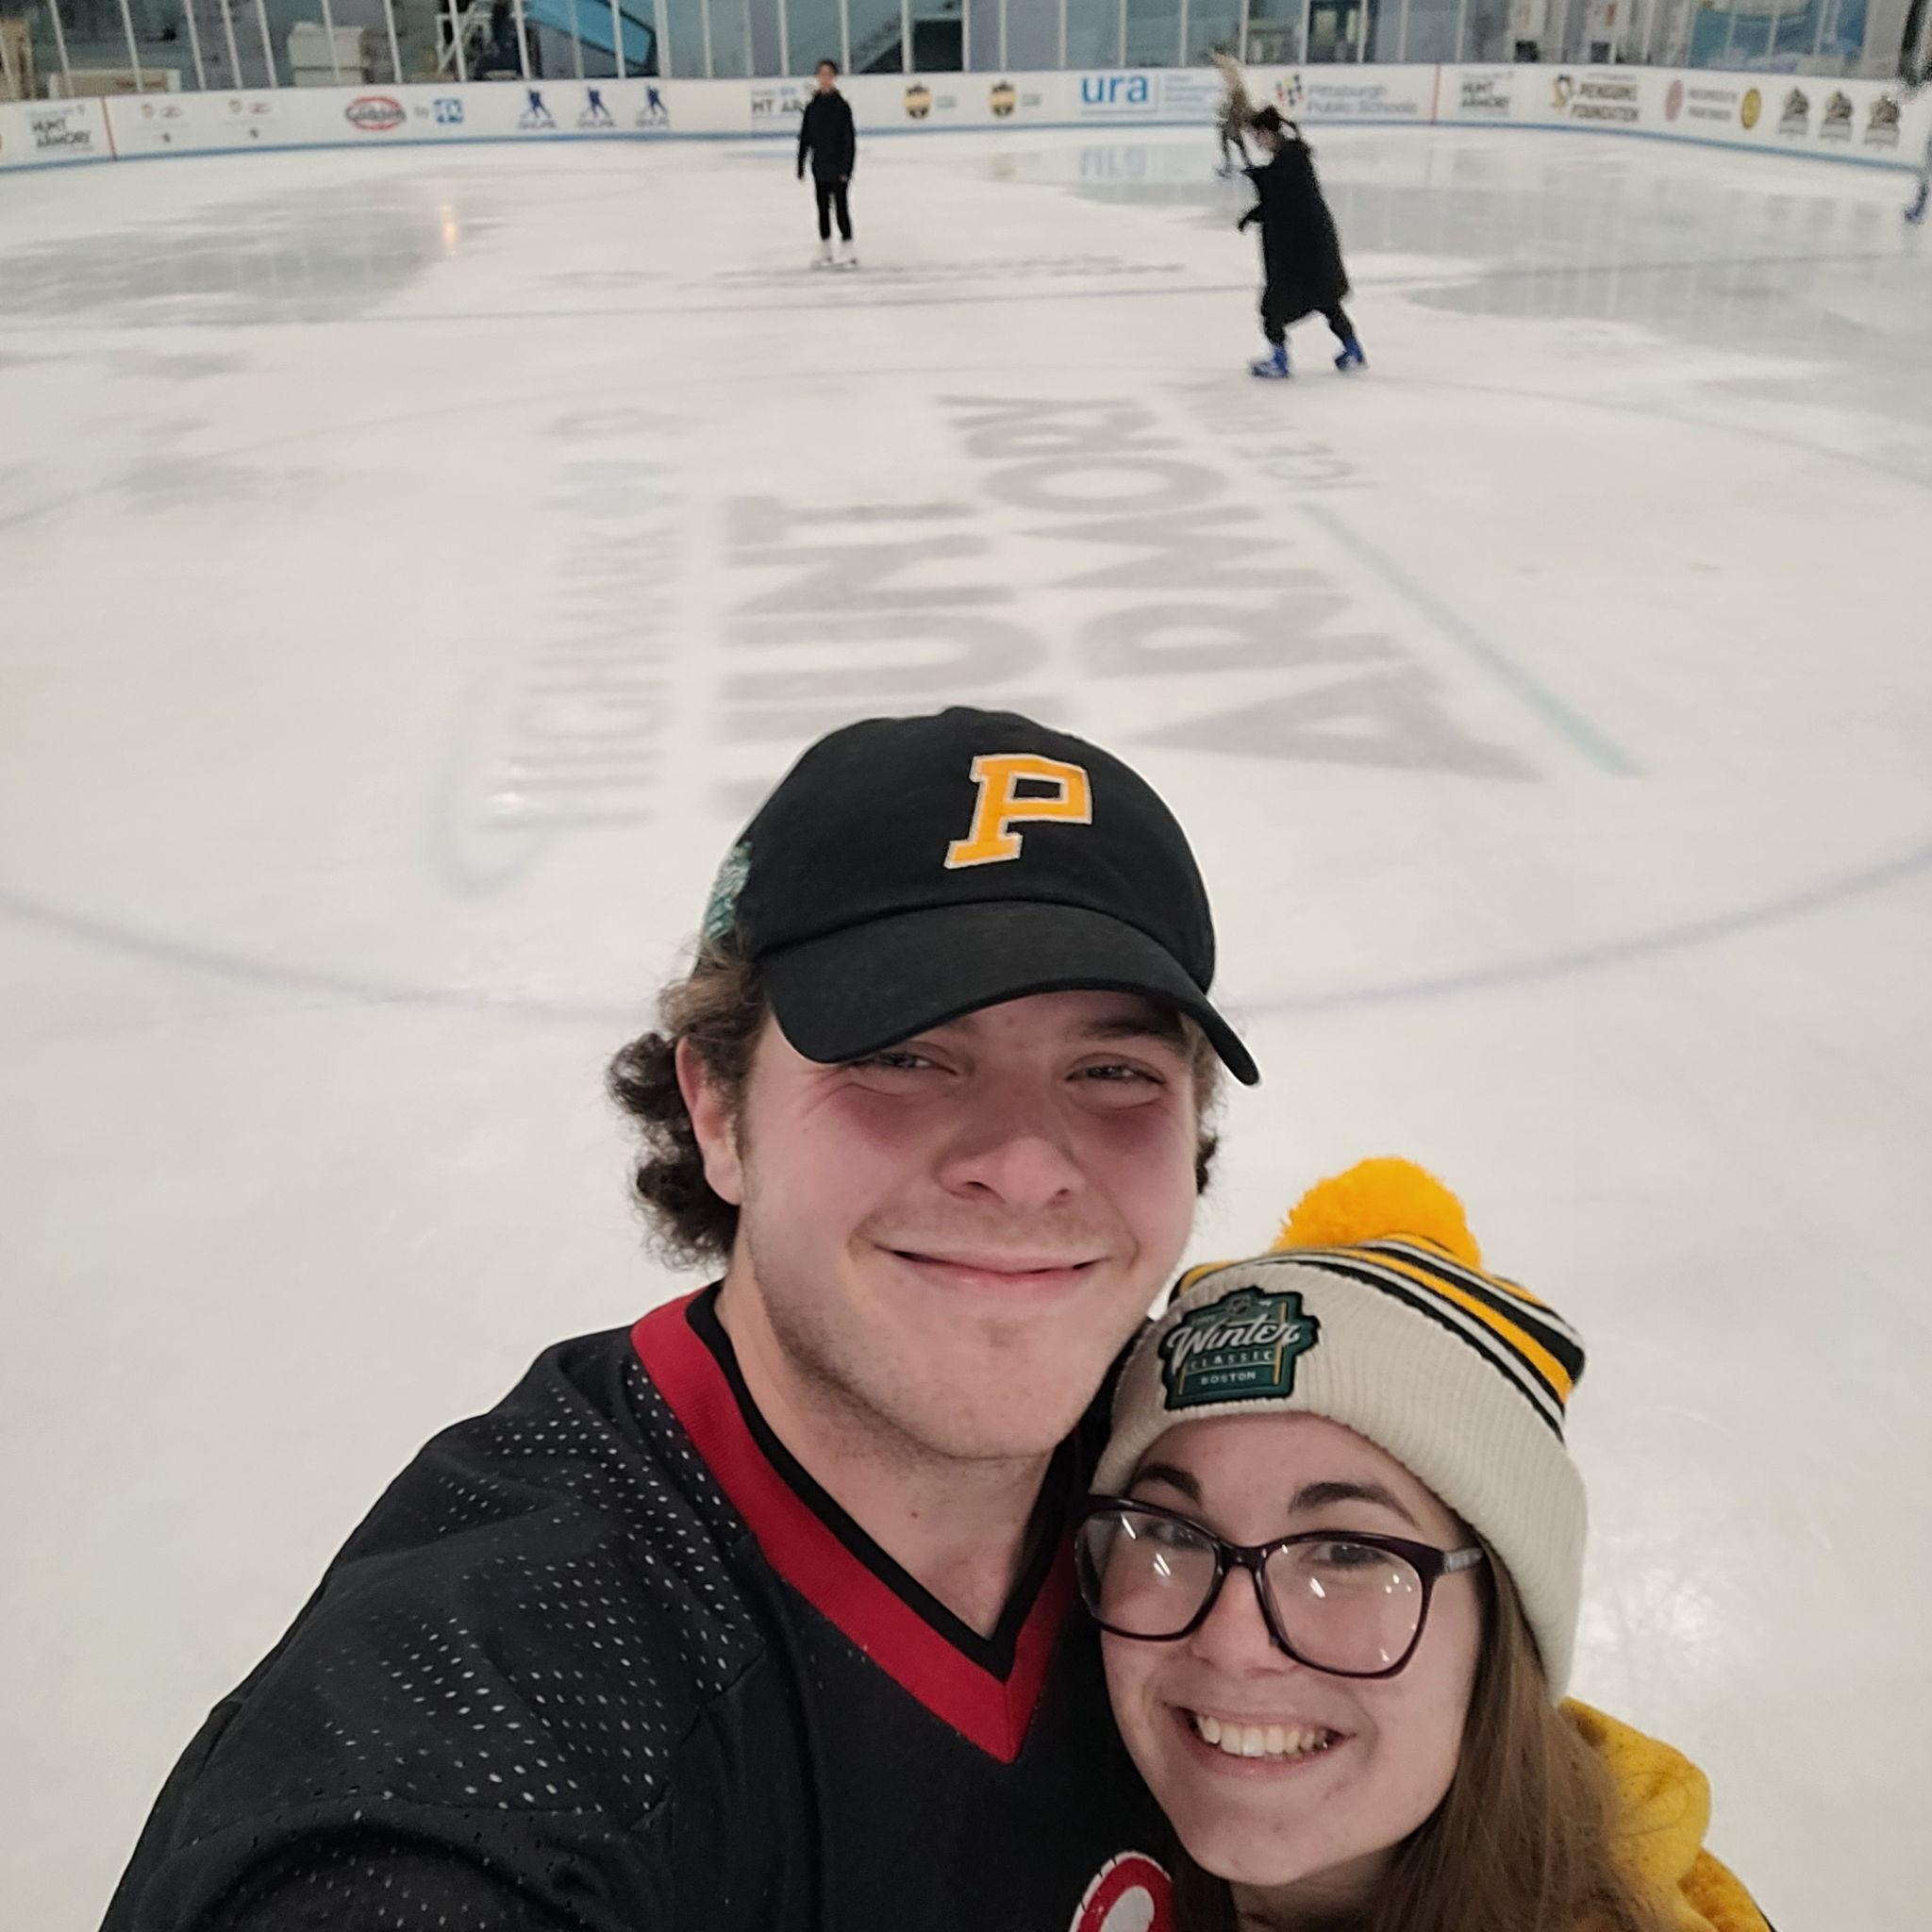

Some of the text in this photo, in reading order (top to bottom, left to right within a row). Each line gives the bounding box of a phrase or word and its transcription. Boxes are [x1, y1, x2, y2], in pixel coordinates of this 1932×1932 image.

[1082, 75, 1148, 103] ura
[944, 754, 1092, 869] P
[1166, 1313, 1301, 1377] Winter
[1191, 1350, 1274, 1370] CLASSIC
[1201, 1371, 1257, 1386] BOSTON
